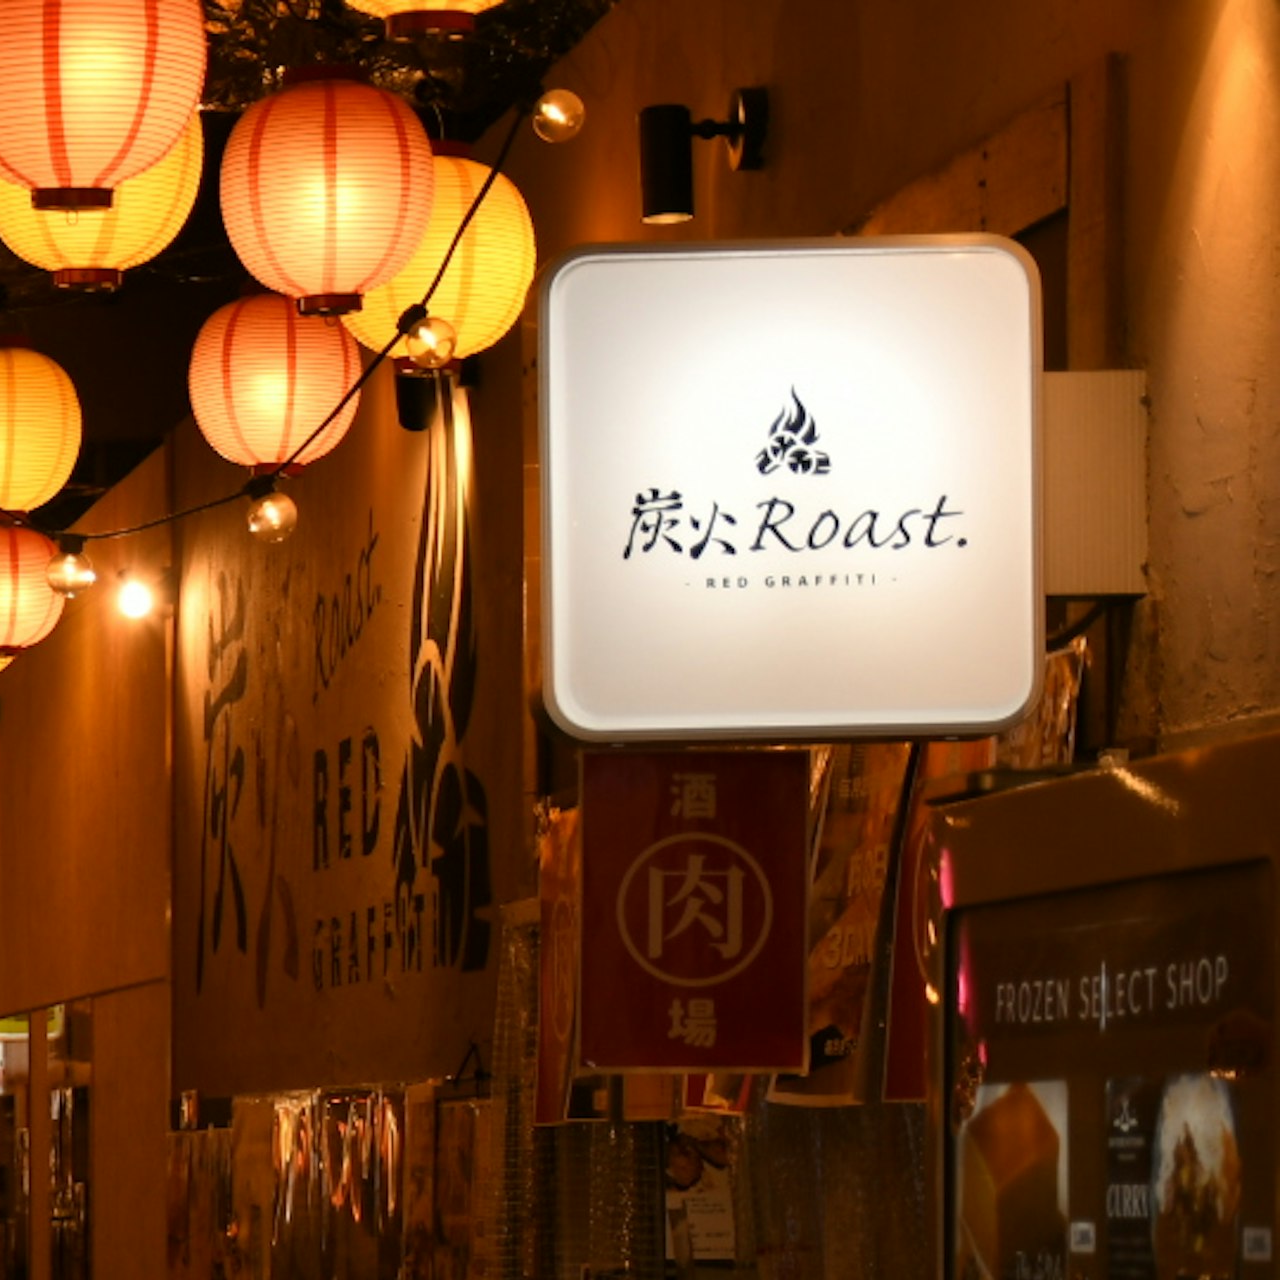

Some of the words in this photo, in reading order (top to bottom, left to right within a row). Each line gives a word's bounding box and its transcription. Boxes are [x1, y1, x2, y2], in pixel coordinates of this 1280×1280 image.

[623, 487, 737, 560] 炭火
[749, 494, 968, 552] Roast.
[705, 576, 749, 589] RED
[764, 572, 878, 589] GRAFFITI
[312, 723, 383, 872] RED
[994, 979, 1071, 1024] FROZEN
[1077, 966, 1158, 1022] SELECT
[1165, 953, 1230, 1011] SHOP
